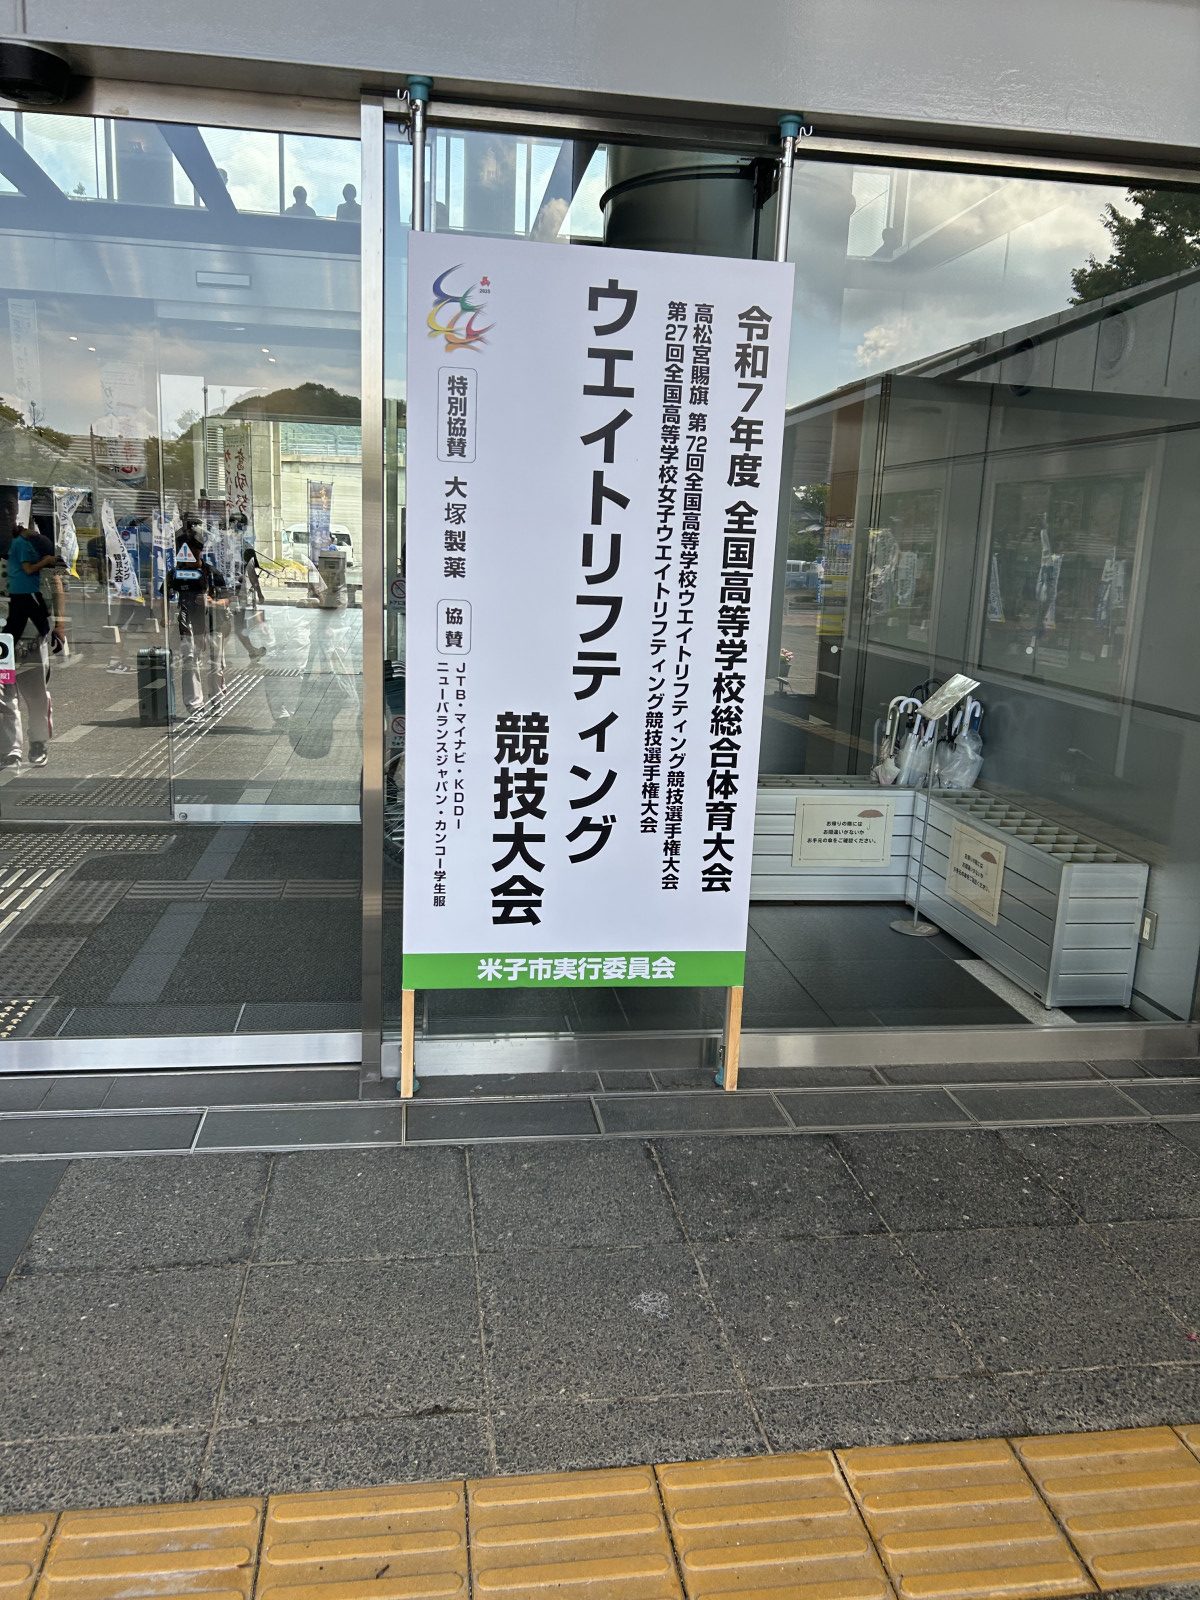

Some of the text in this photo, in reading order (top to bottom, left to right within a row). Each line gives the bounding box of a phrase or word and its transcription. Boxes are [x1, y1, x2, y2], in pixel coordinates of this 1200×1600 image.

[443, 476, 468, 579] 大塚製薬
[446, 375, 468, 458] 特別協賛
[445, 608, 463, 649] 協賛
[565, 278, 638, 864] ウエイトリフティング
[640, 300, 688, 834] 第27回全国高等学校女子ウエイトリフティング競技選手権大会
[661, 303, 714, 890] 高松宮賜旗 第72回全国高等学校ウエイトリフティング競技選手権大会
[701, 305, 773, 893] 令和7年度 全国高等学校総合体育大会
[433, 662, 450, 907] ニューバランスジャパン・カンコー学生服
[490, 711, 550, 926] 競技大会
[477, 956, 676, 981] 米子市実行委員会
